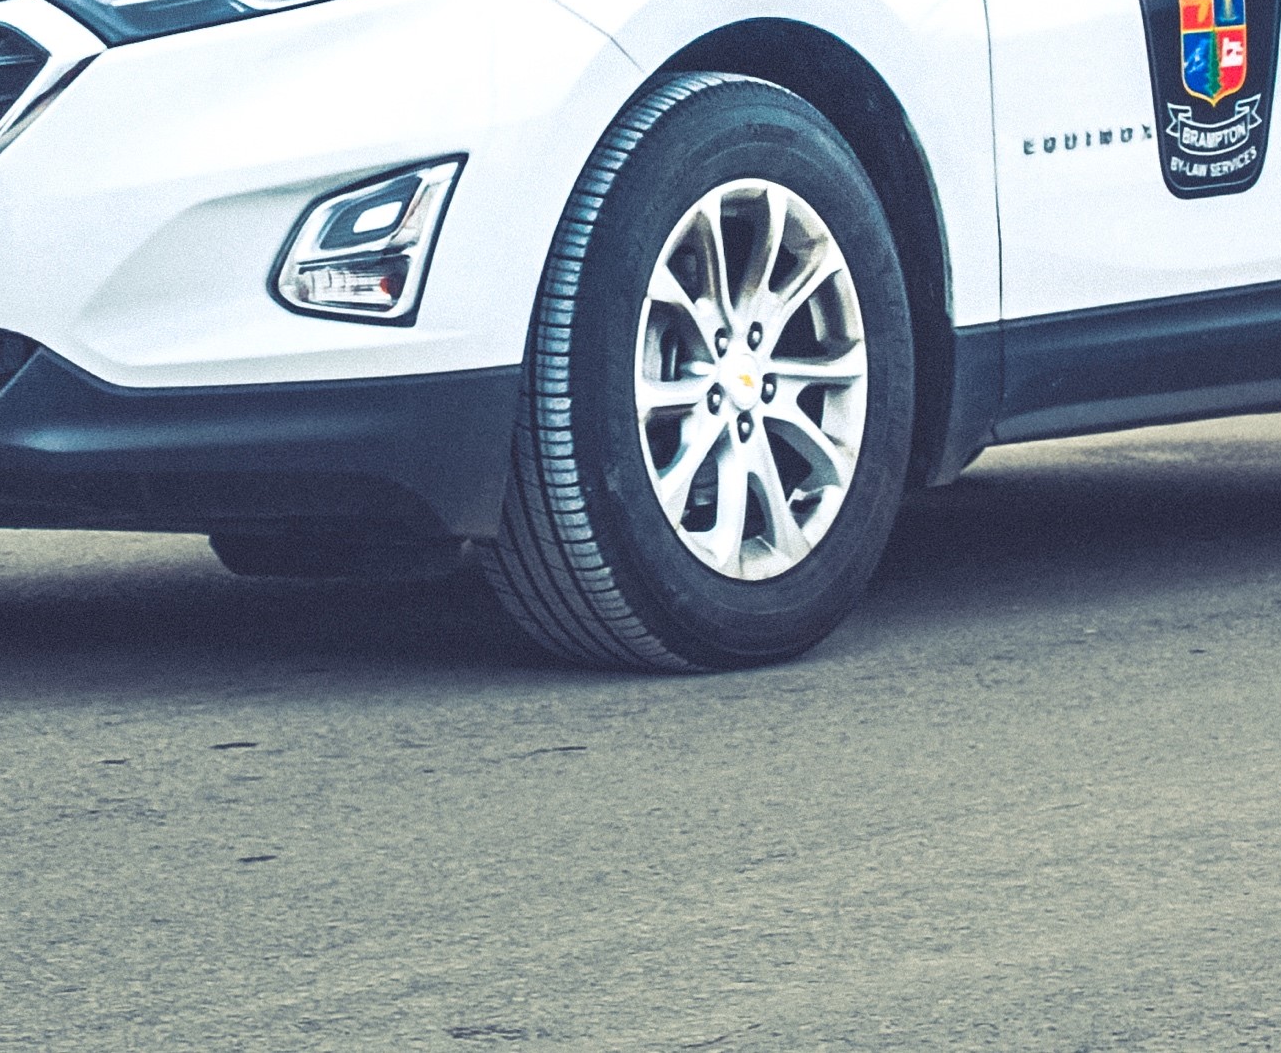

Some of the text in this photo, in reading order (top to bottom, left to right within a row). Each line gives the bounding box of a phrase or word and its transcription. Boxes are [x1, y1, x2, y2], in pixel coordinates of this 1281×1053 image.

[1182, 121, 1246, 148] BRAMPTON
[1170, 145, 1257, 177] BY-LAW SERVICES
